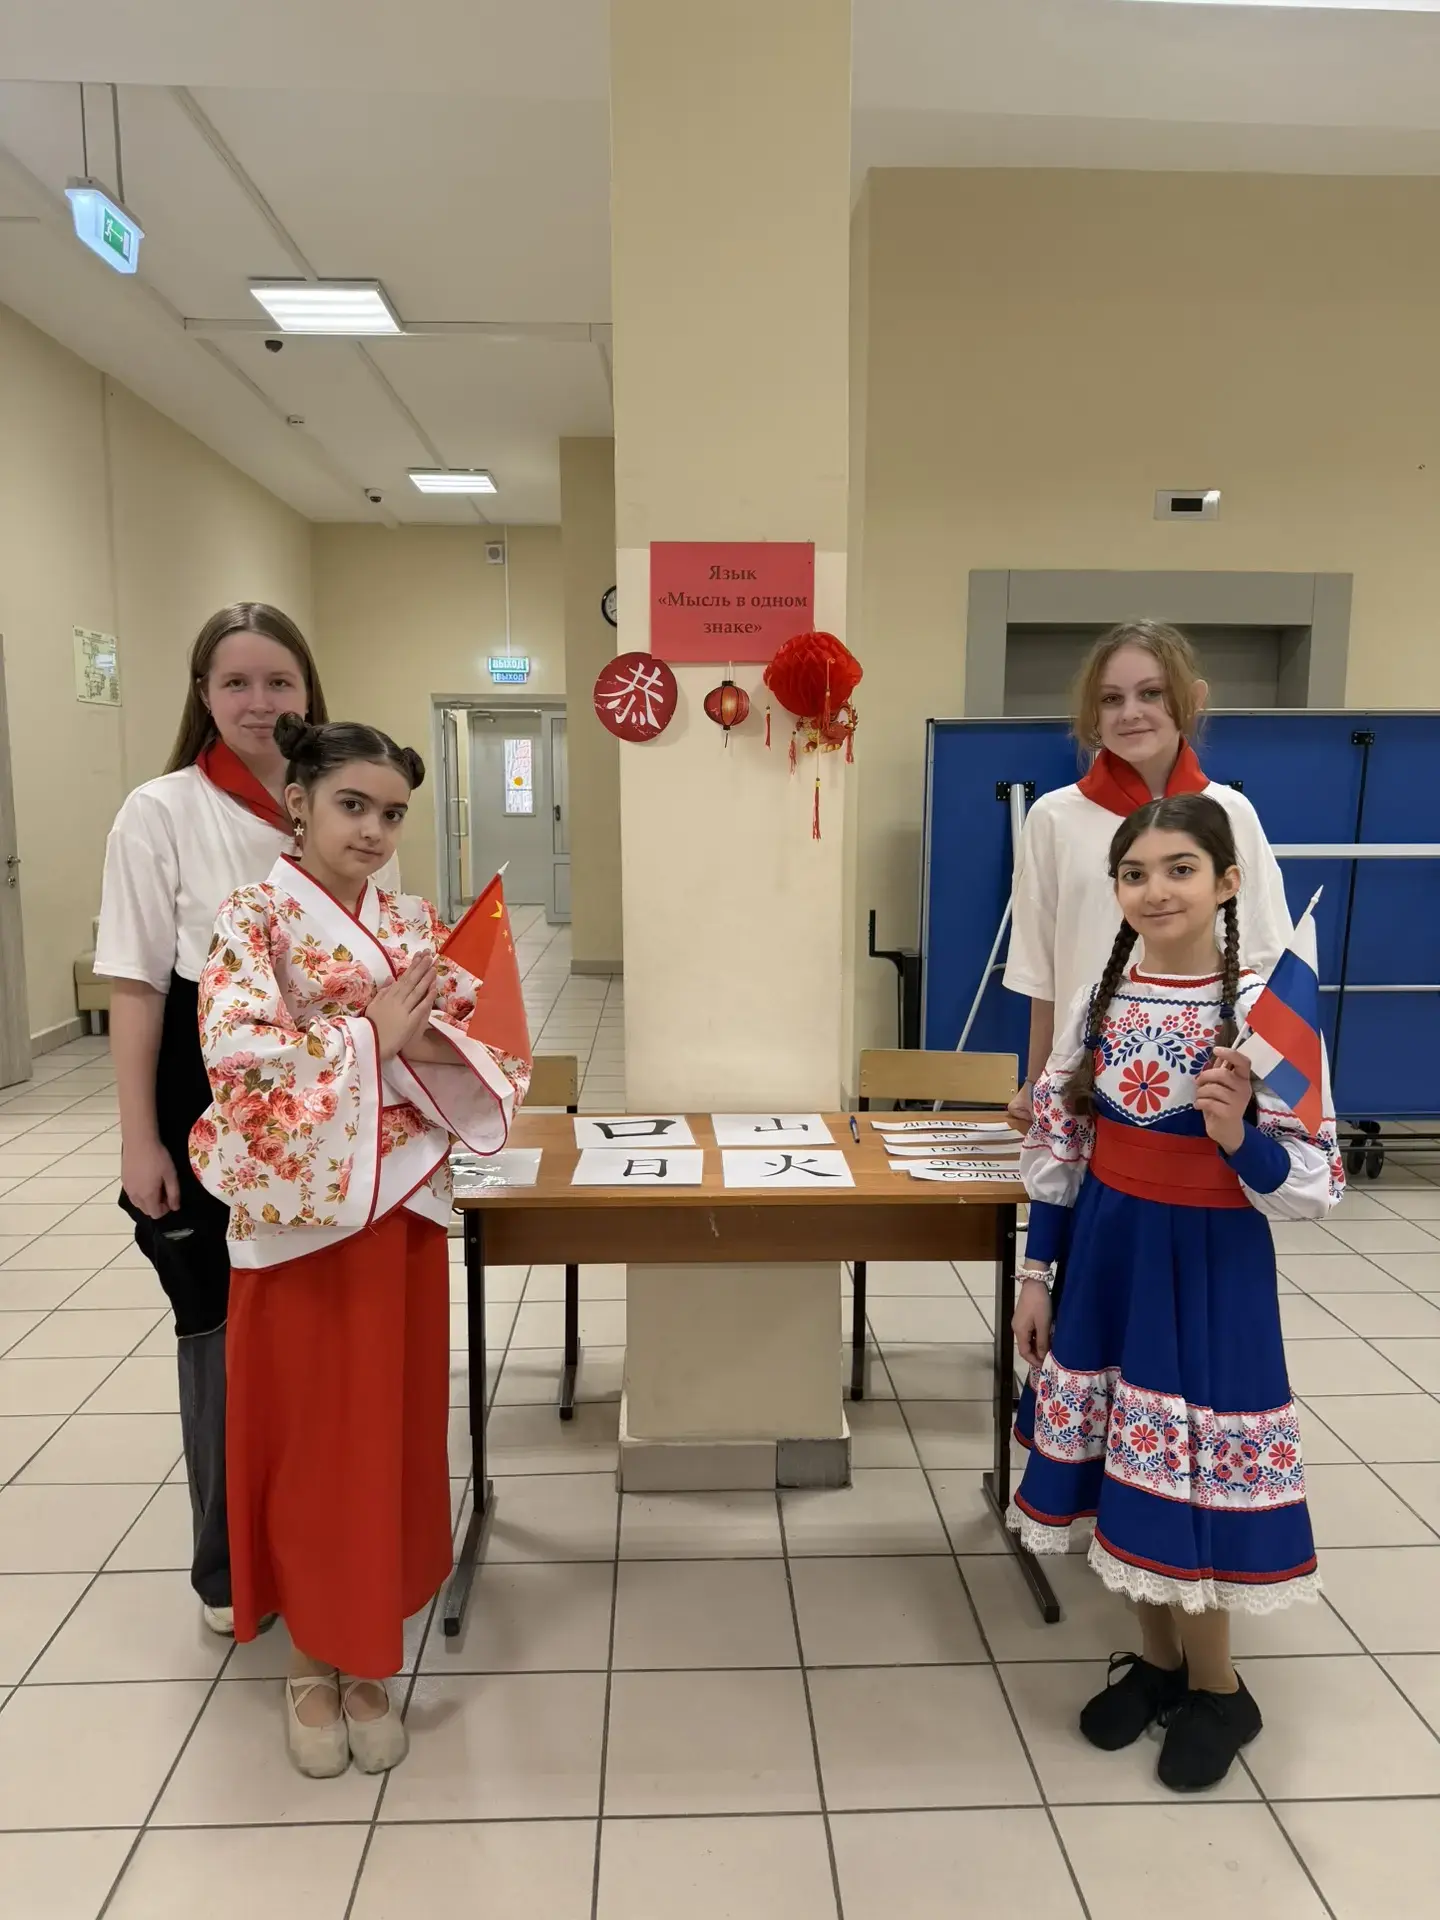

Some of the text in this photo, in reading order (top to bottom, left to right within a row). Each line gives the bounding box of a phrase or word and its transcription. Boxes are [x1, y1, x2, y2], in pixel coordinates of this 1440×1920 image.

[708, 565, 757, 580] Язык
[658, 591, 808, 608] «Мысль в одном
[703, 622, 762, 634] знаке»
[492, 659, 524, 669] ВЫХОД
[597, 662, 664, 730] 恭
[592, 1119, 677, 1139] 口
[753, 1117, 809, 1132] 山
[903, 1121, 979, 1129] ДЕРЕВО
[622, 1158, 668, 1178] 日
[760, 1154, 843, 1178] 火
[930, 1160, 1001, 1168] ОГОНЬ
